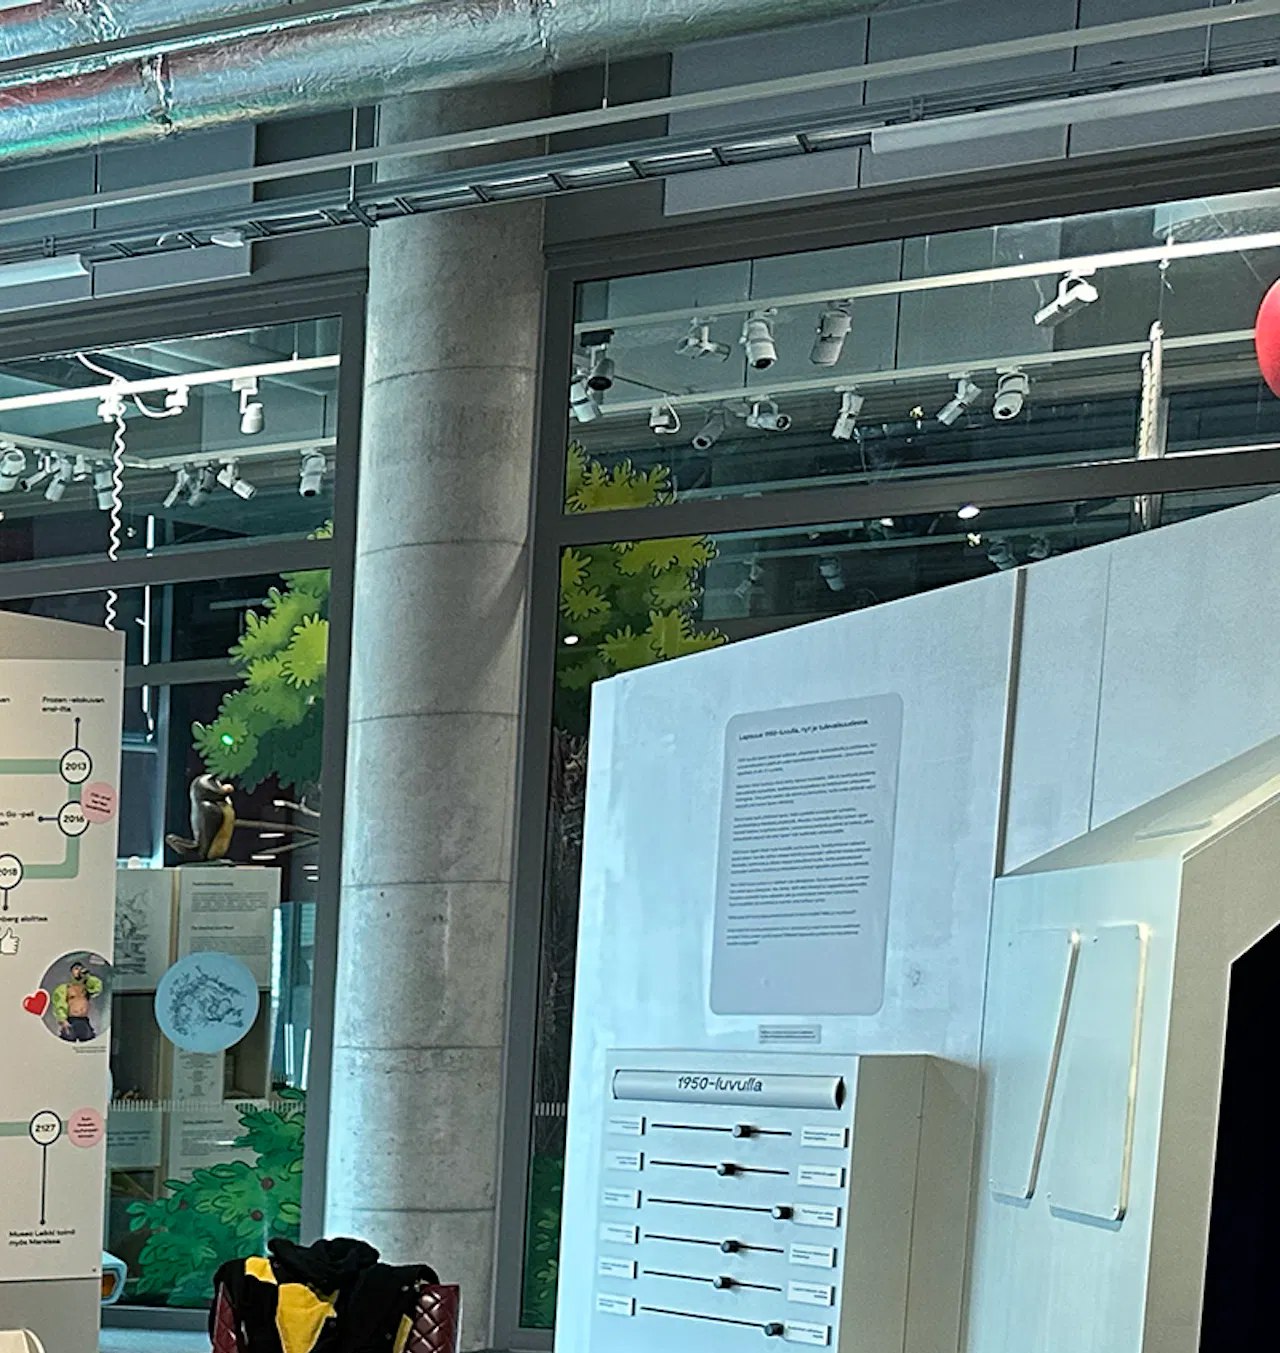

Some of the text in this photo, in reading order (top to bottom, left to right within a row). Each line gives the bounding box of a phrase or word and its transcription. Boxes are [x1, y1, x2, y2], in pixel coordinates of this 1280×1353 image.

[65, 762, 86, 771] 2013
[63, 815, 84, 823] 2016
[677, 1076, 764, 1092] 1950-luvulla
[35, 1124, 56, 1132] 2127
